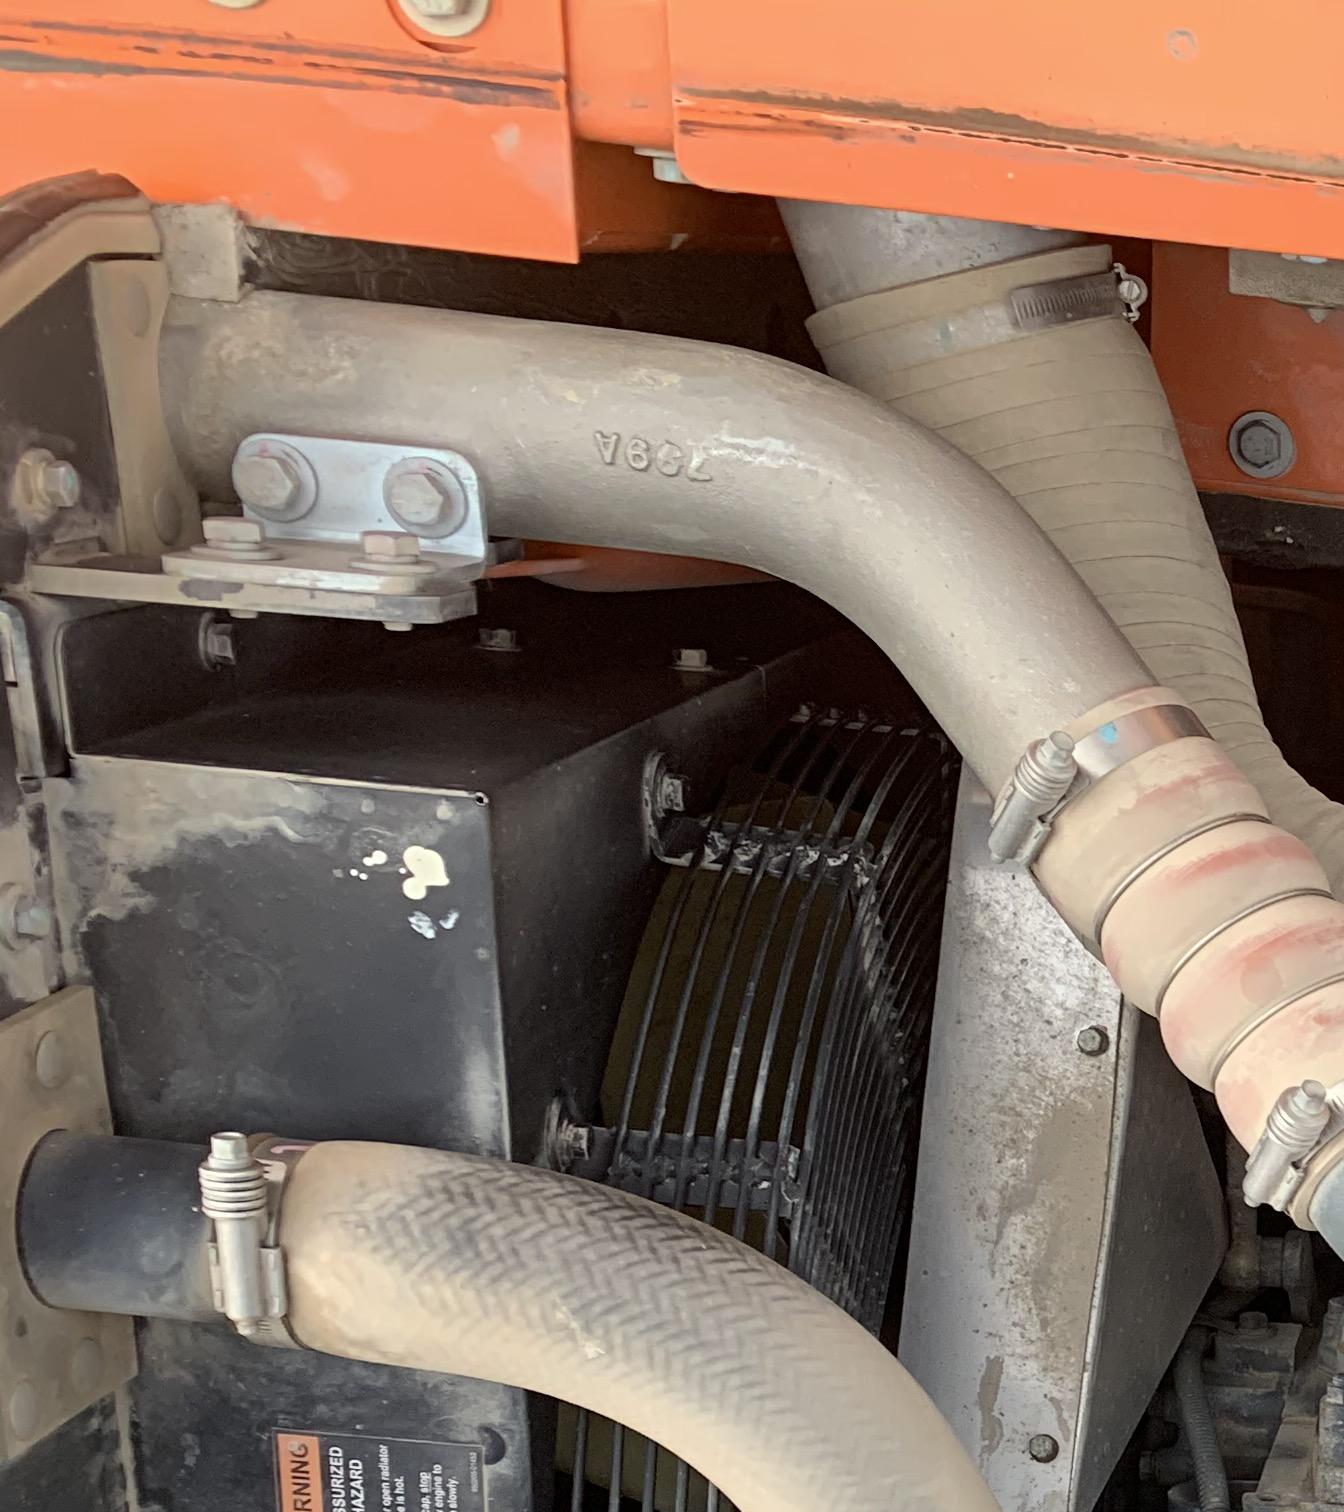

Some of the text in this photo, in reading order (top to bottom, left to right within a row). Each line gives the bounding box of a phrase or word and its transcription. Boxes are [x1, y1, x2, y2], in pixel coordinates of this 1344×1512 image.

[379, 1444, 389, 1485] radiator
[432, 1464, 442, 1475] to
[420, 1471, 432, 1493] stop
[433, 1478, 446, 1507] engine
[382, 1485, 393, 1506] open
